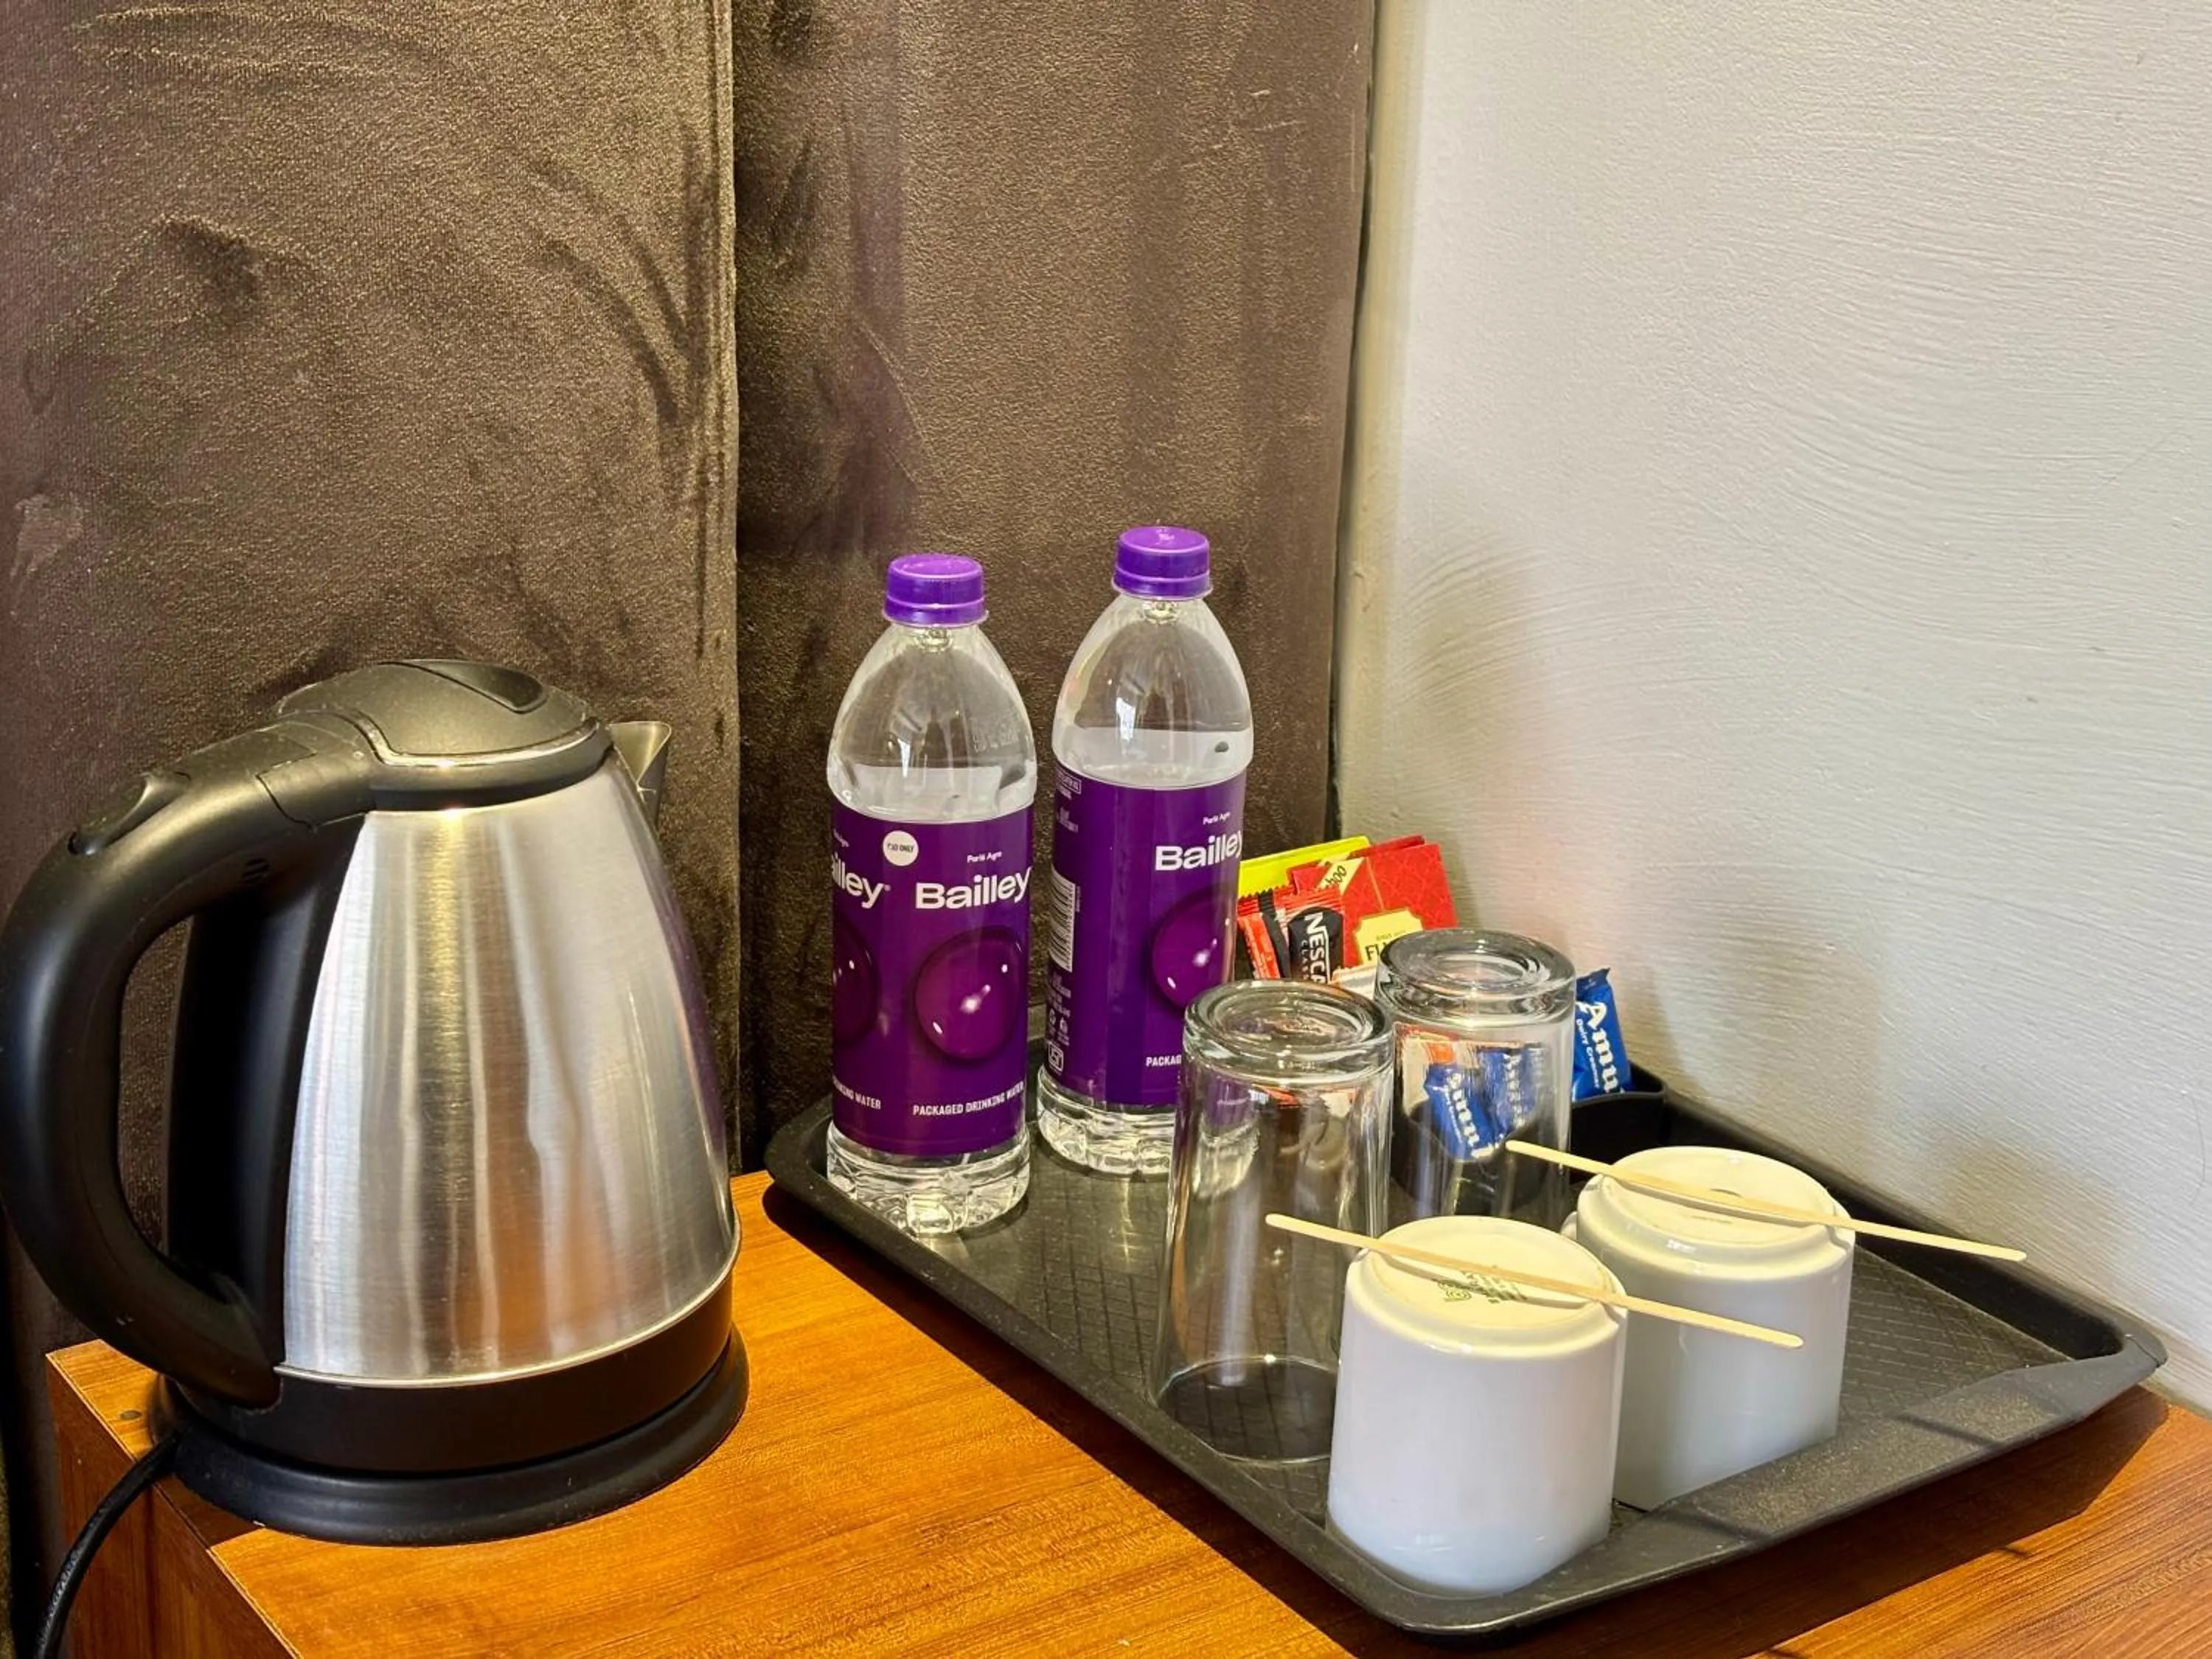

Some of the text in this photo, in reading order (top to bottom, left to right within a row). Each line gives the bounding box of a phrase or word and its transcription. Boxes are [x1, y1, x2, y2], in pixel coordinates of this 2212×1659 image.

[915, 866, 1032, 909] Bailley
[1304, 912, 1330, 984] NESCA
[1146, 1054, 1182, 1067] PACKAG
[1574, 1001, 1624, 1093] Amu
[855, 1091, 882, 1110] WATER
[913, 1080, 1024, 1116] PACKAGED DRINKING WATER
